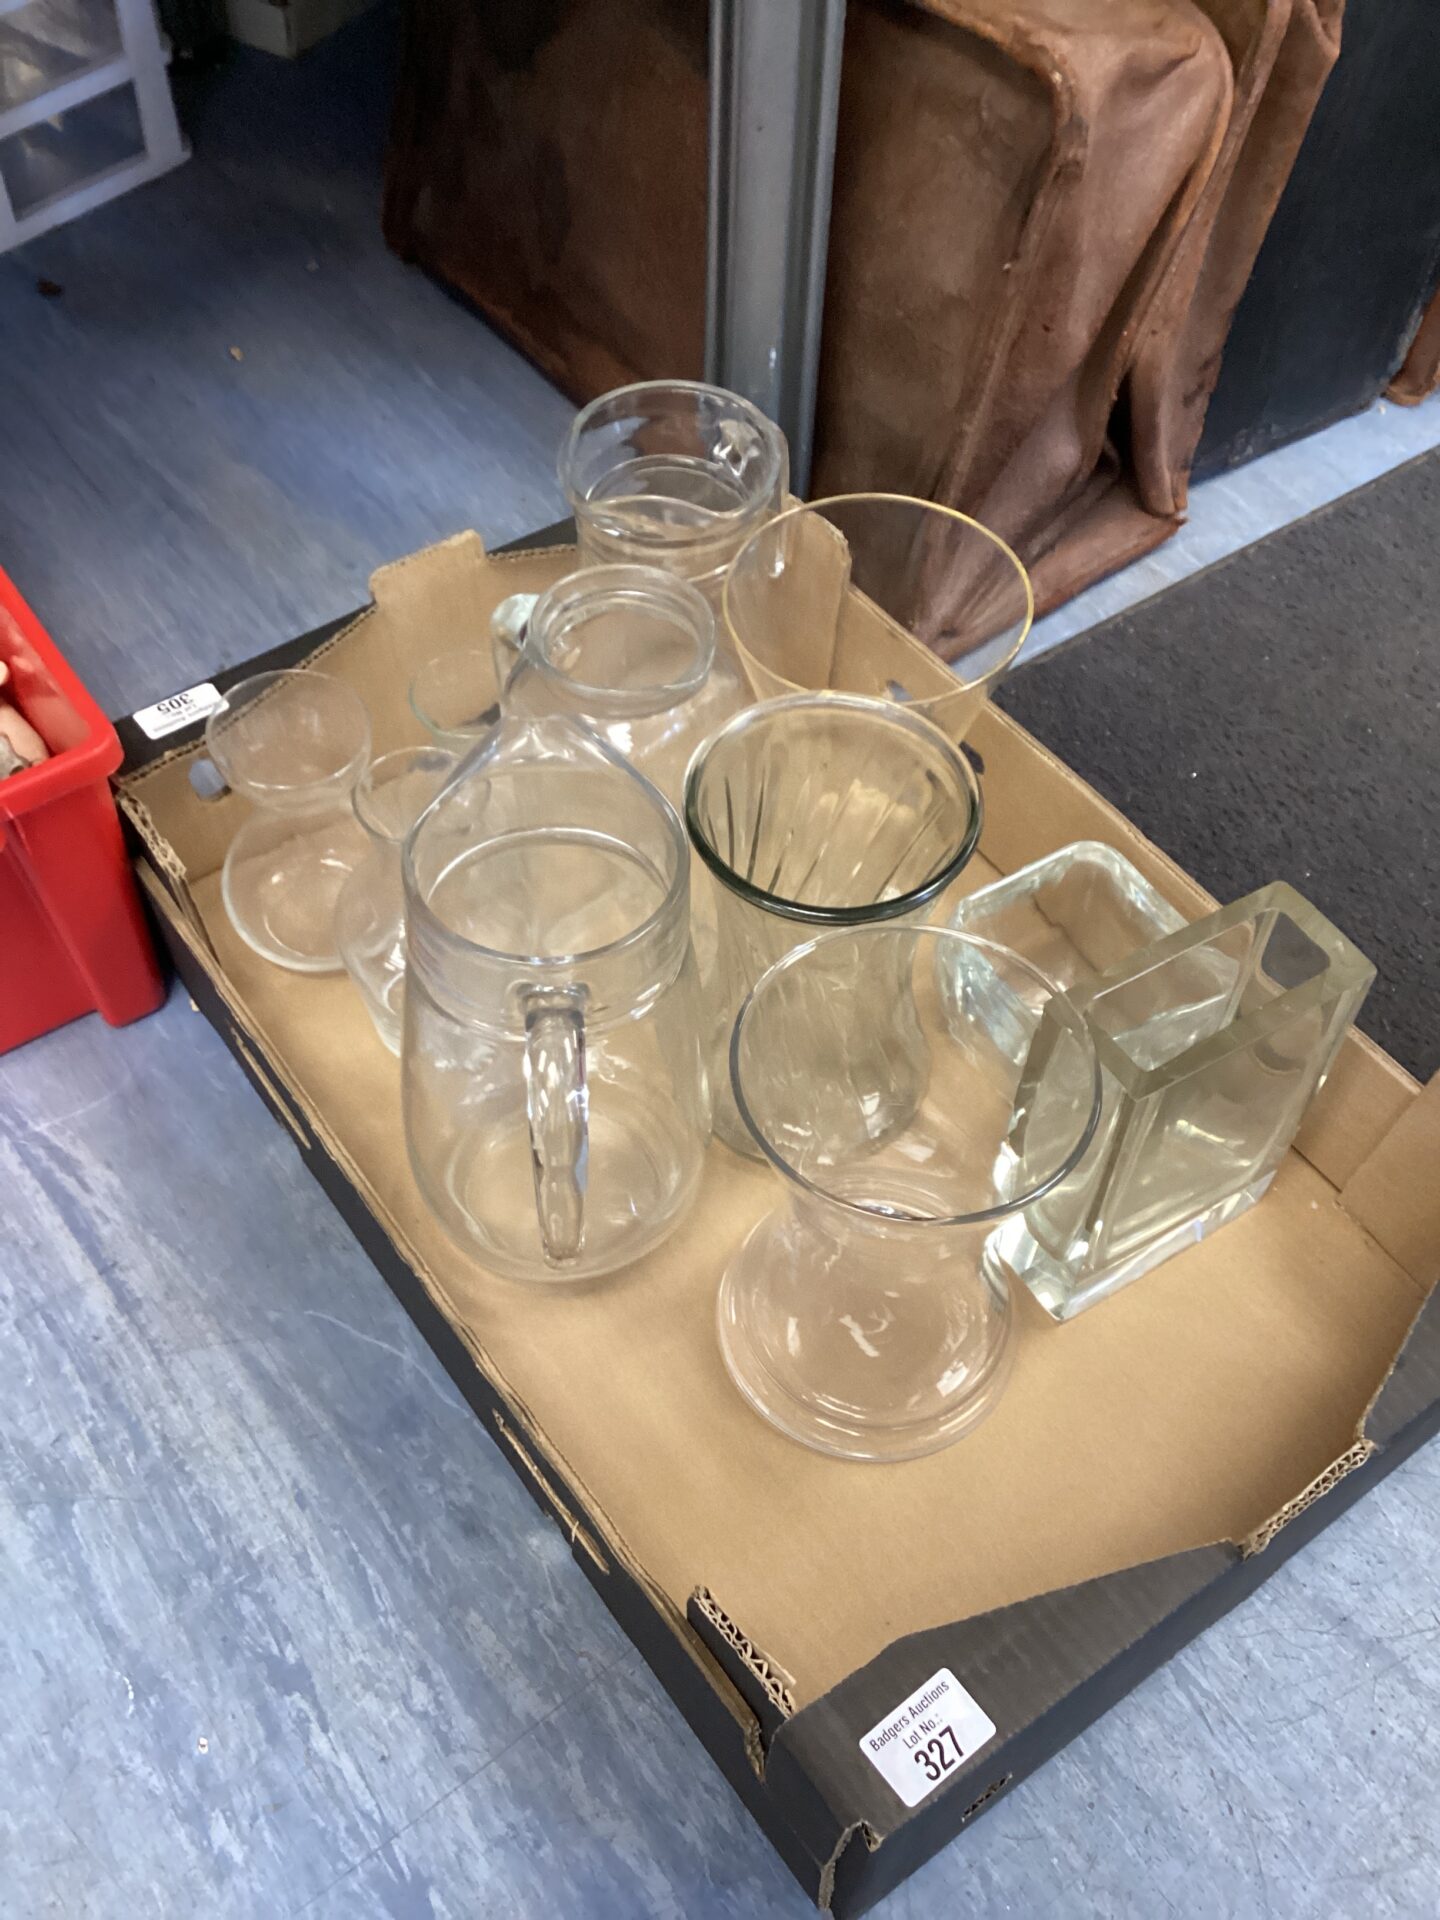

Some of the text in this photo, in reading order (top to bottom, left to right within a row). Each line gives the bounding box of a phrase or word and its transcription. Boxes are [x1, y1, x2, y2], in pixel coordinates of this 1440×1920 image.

[157, 693, 193, 713] 305
[869, 1681, 950, 1751] Badgers Auctions
[902, 1731, 922, 1749] Lot
[914, 1725, 964, 1781] 327
